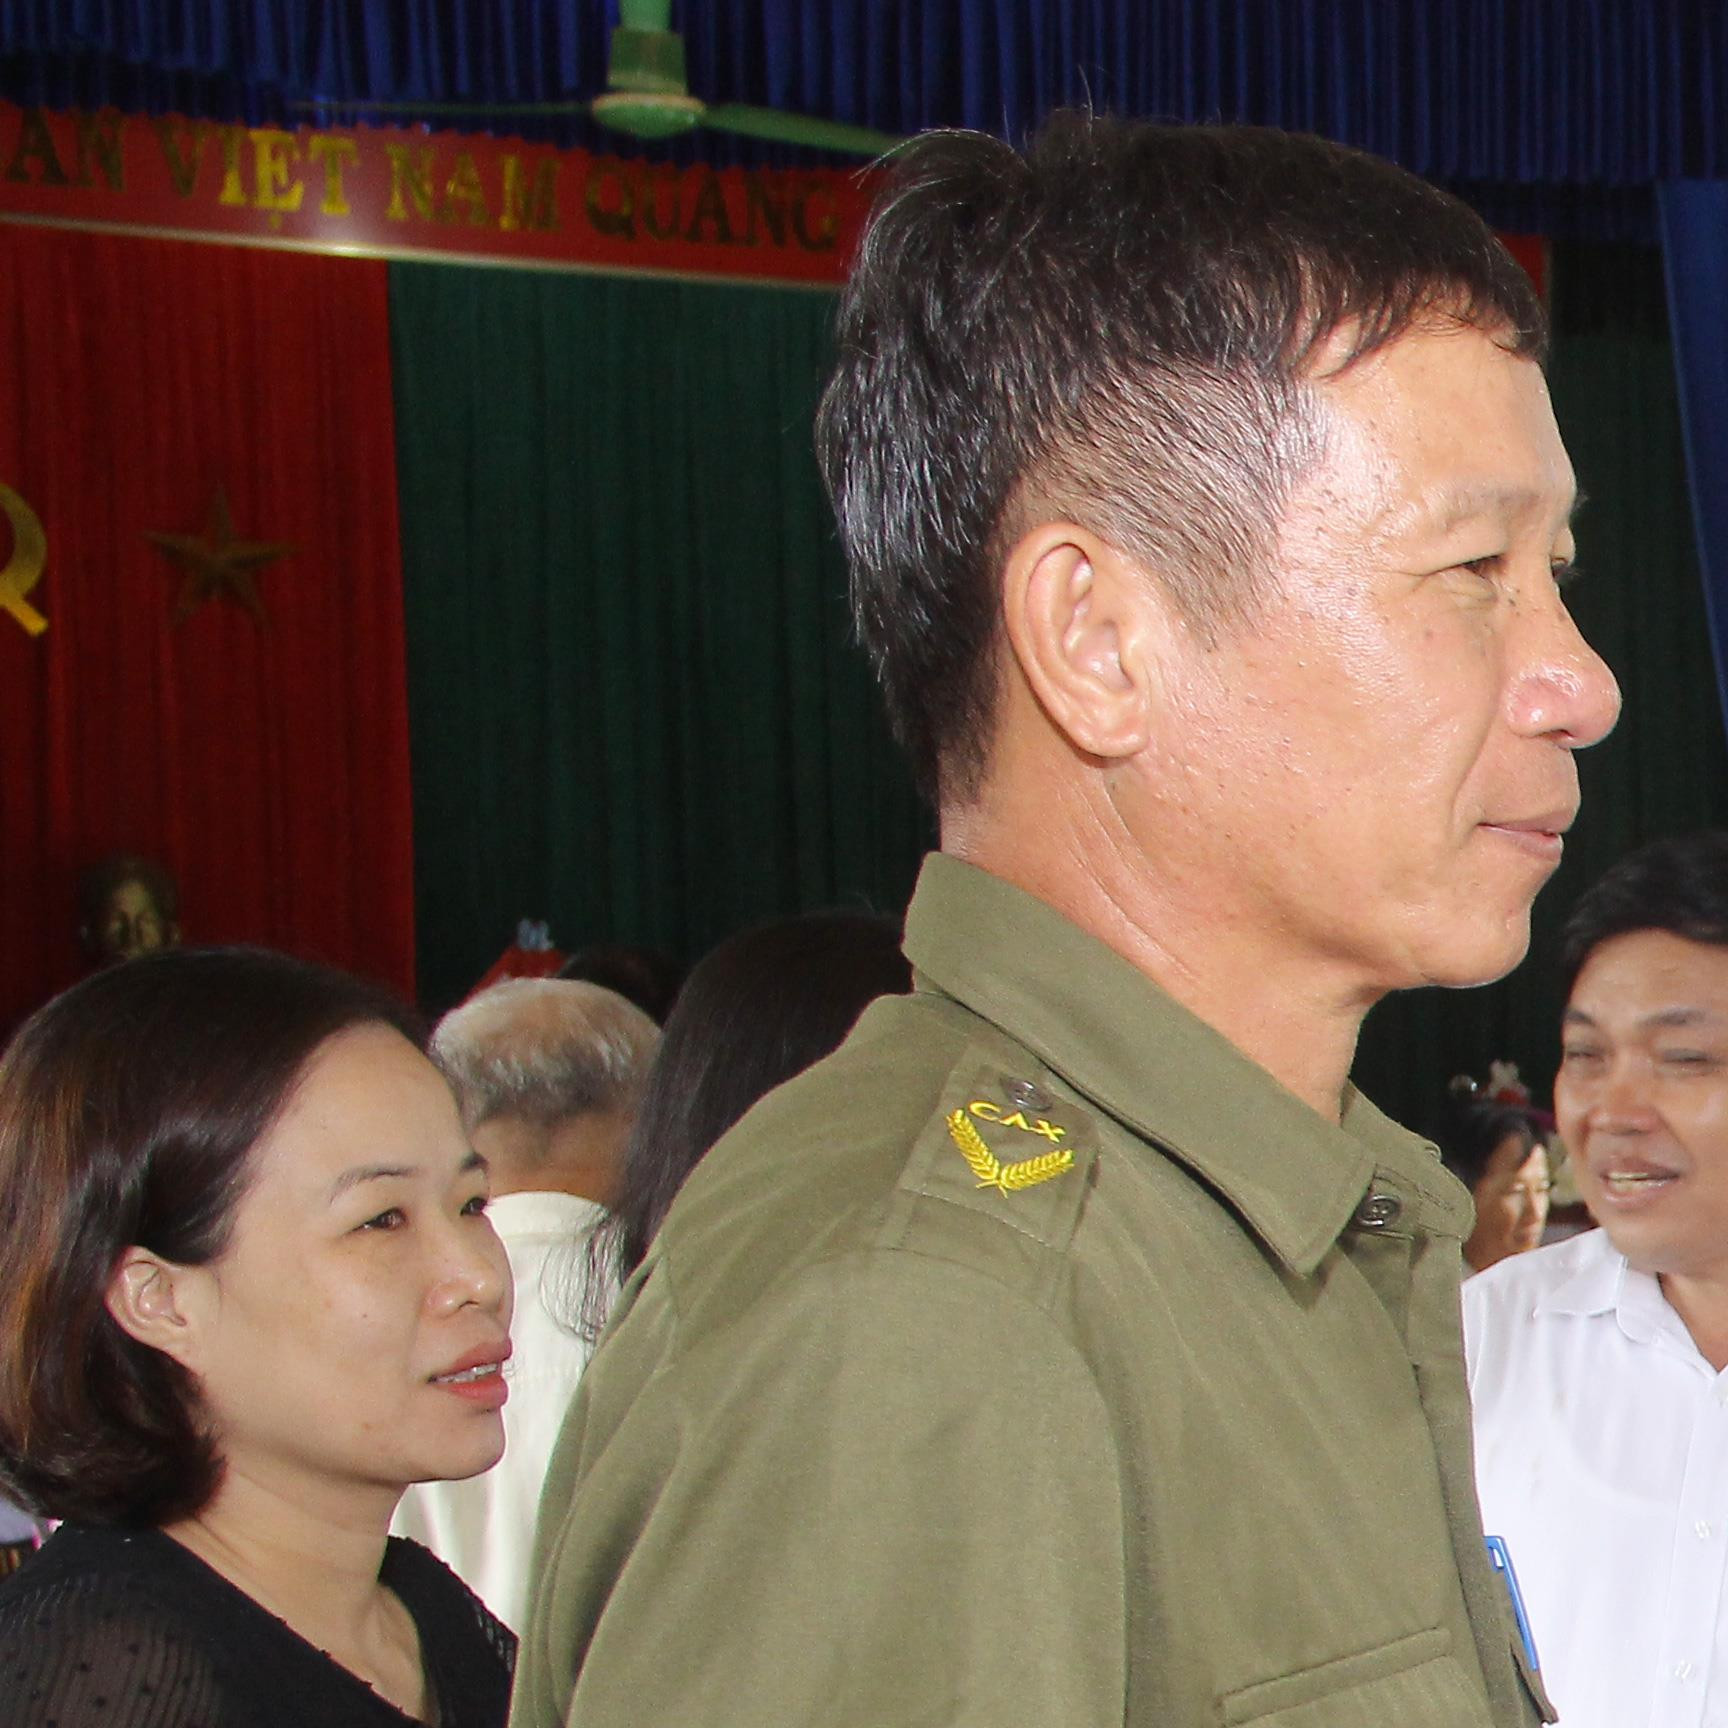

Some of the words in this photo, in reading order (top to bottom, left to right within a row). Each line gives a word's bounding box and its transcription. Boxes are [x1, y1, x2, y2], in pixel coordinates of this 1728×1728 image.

[384, 143, 562, 233] NAM
[585, 161, 838, 252] QUANG
[968, 1100, 1067, 1143] CAX
